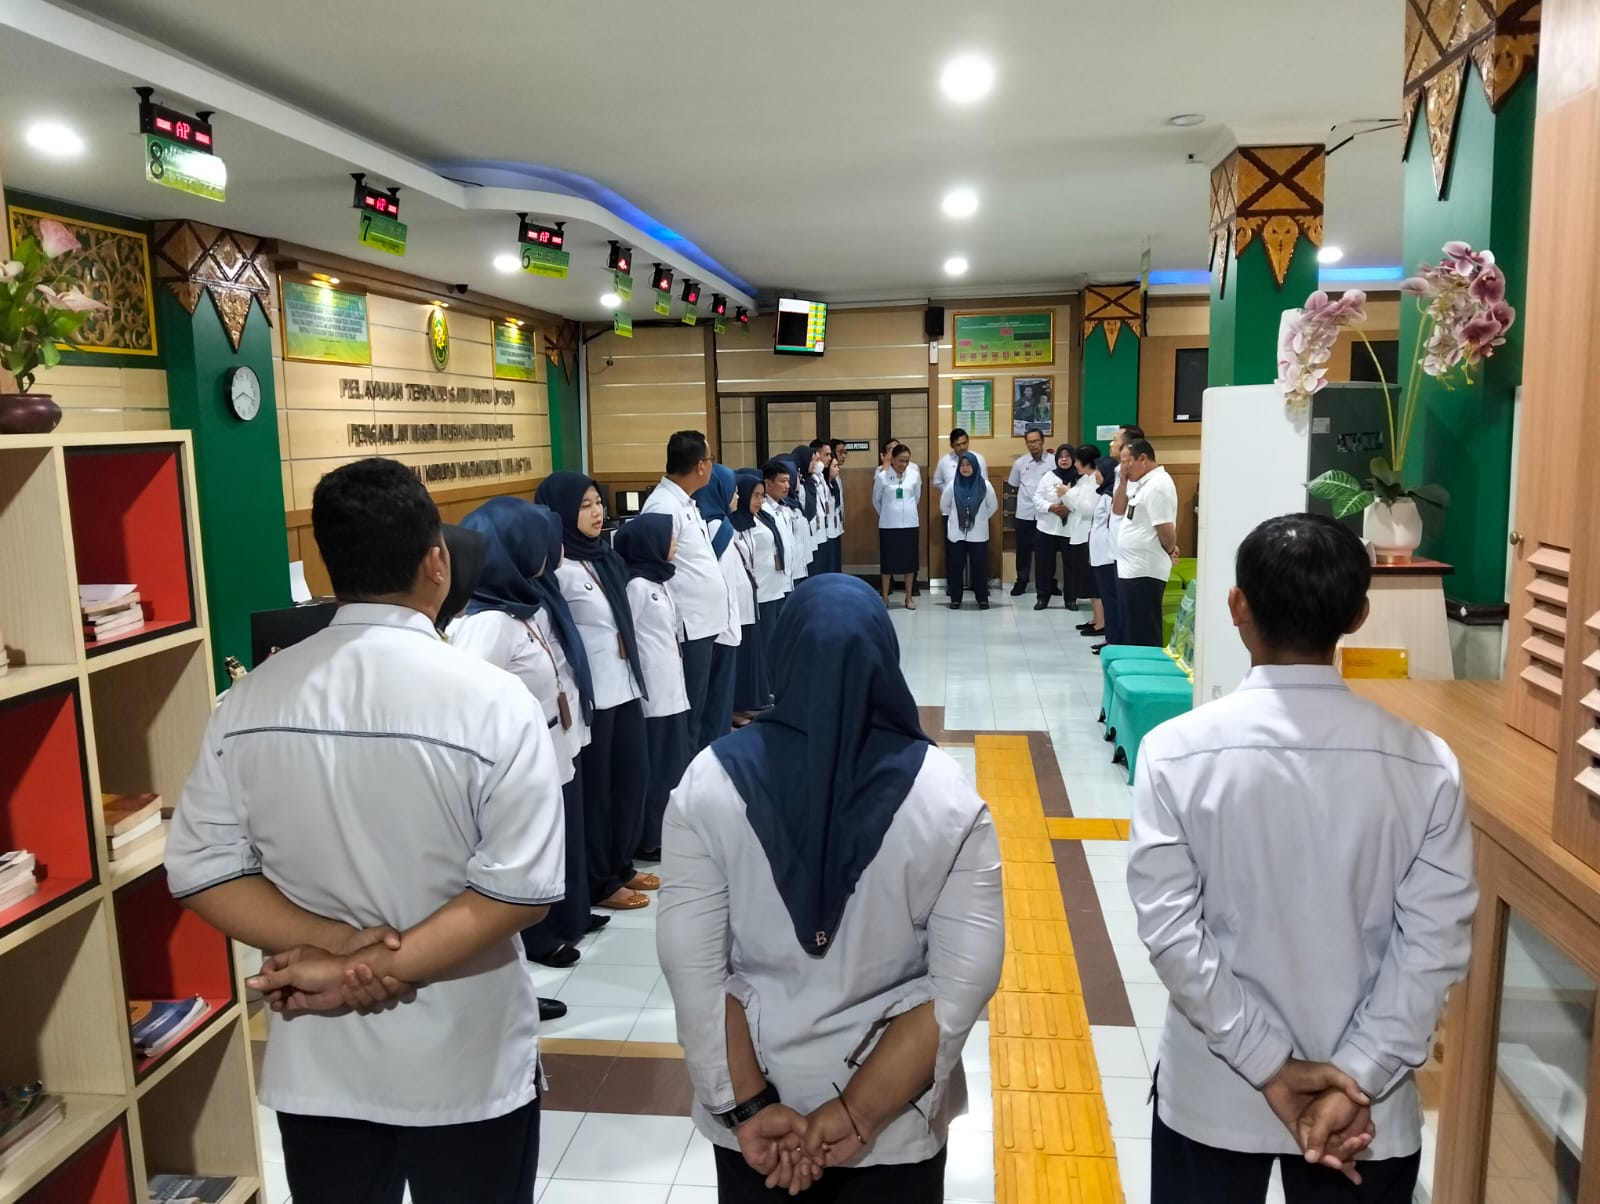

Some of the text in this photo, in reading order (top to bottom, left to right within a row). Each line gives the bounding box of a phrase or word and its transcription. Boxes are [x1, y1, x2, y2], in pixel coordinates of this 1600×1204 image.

[175, 121, 191, 141] AP
[150, 141, 164, 180] 8
[376, 197, 387, 212] AP
[362, 214, 372, 242] 7
[522, 248, 531, 269] 6
[815, 931, 828, 947] B
